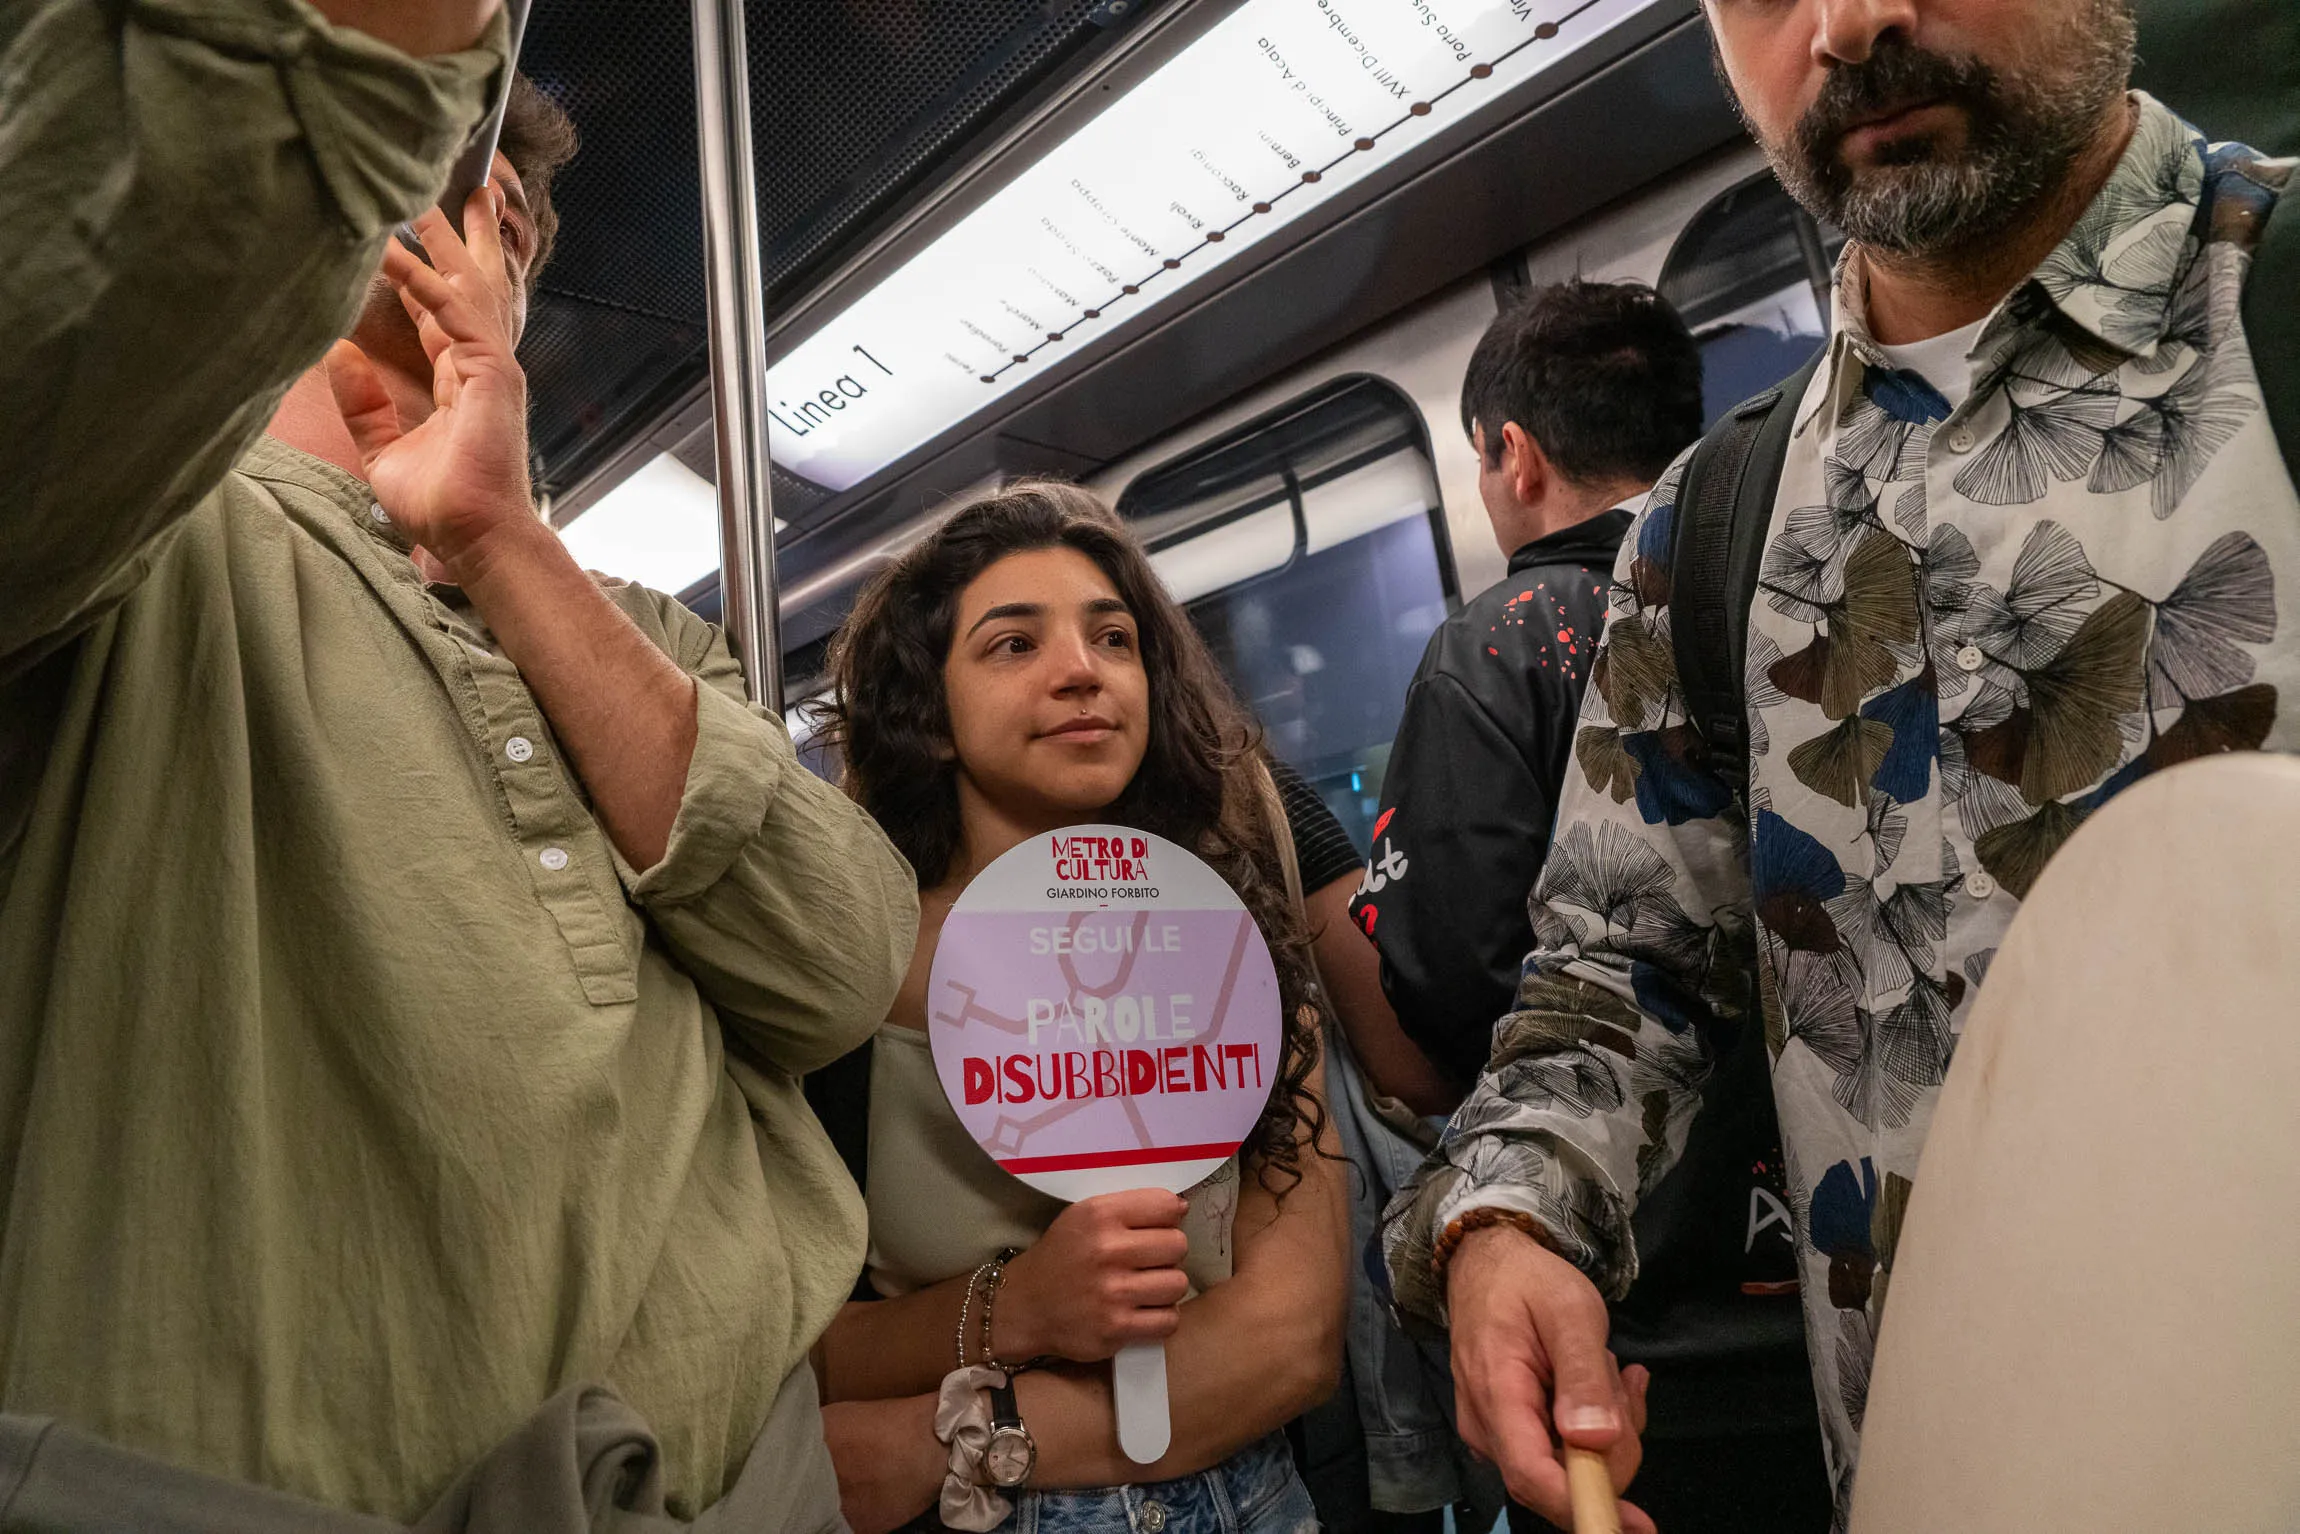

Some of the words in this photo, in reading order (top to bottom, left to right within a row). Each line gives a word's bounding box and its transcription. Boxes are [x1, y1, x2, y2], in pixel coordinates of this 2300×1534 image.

[1317, 0, 1378, 70] Dicembre
[1436, 24, 1473, 62] Porta
[1372, 66, 1412, 100] XVIII
[1306, 92, 1353, 137] Principi
[1168, 200, 1206, 230] Rivoli
[768, 373, 868, 437] Linea
[852, 344, 893, 375] 1
[1051, 836, 1124, 859] METRO
[1131, 837, 1149, 859] DI
[1056, 858, 1148, 881] CULTURA
[1046, 887, 1108, 899] GIARDINO
[1111, 887, 1160, 899] FORBITO
[1030, 927, 1135, 955] SEGUI
[1146, 925, 1181, 953] LE
[1026, 994, 1197, 1046] PAROLE
[963, 1042, 1262, 1106] DISUBBIDIENTI
